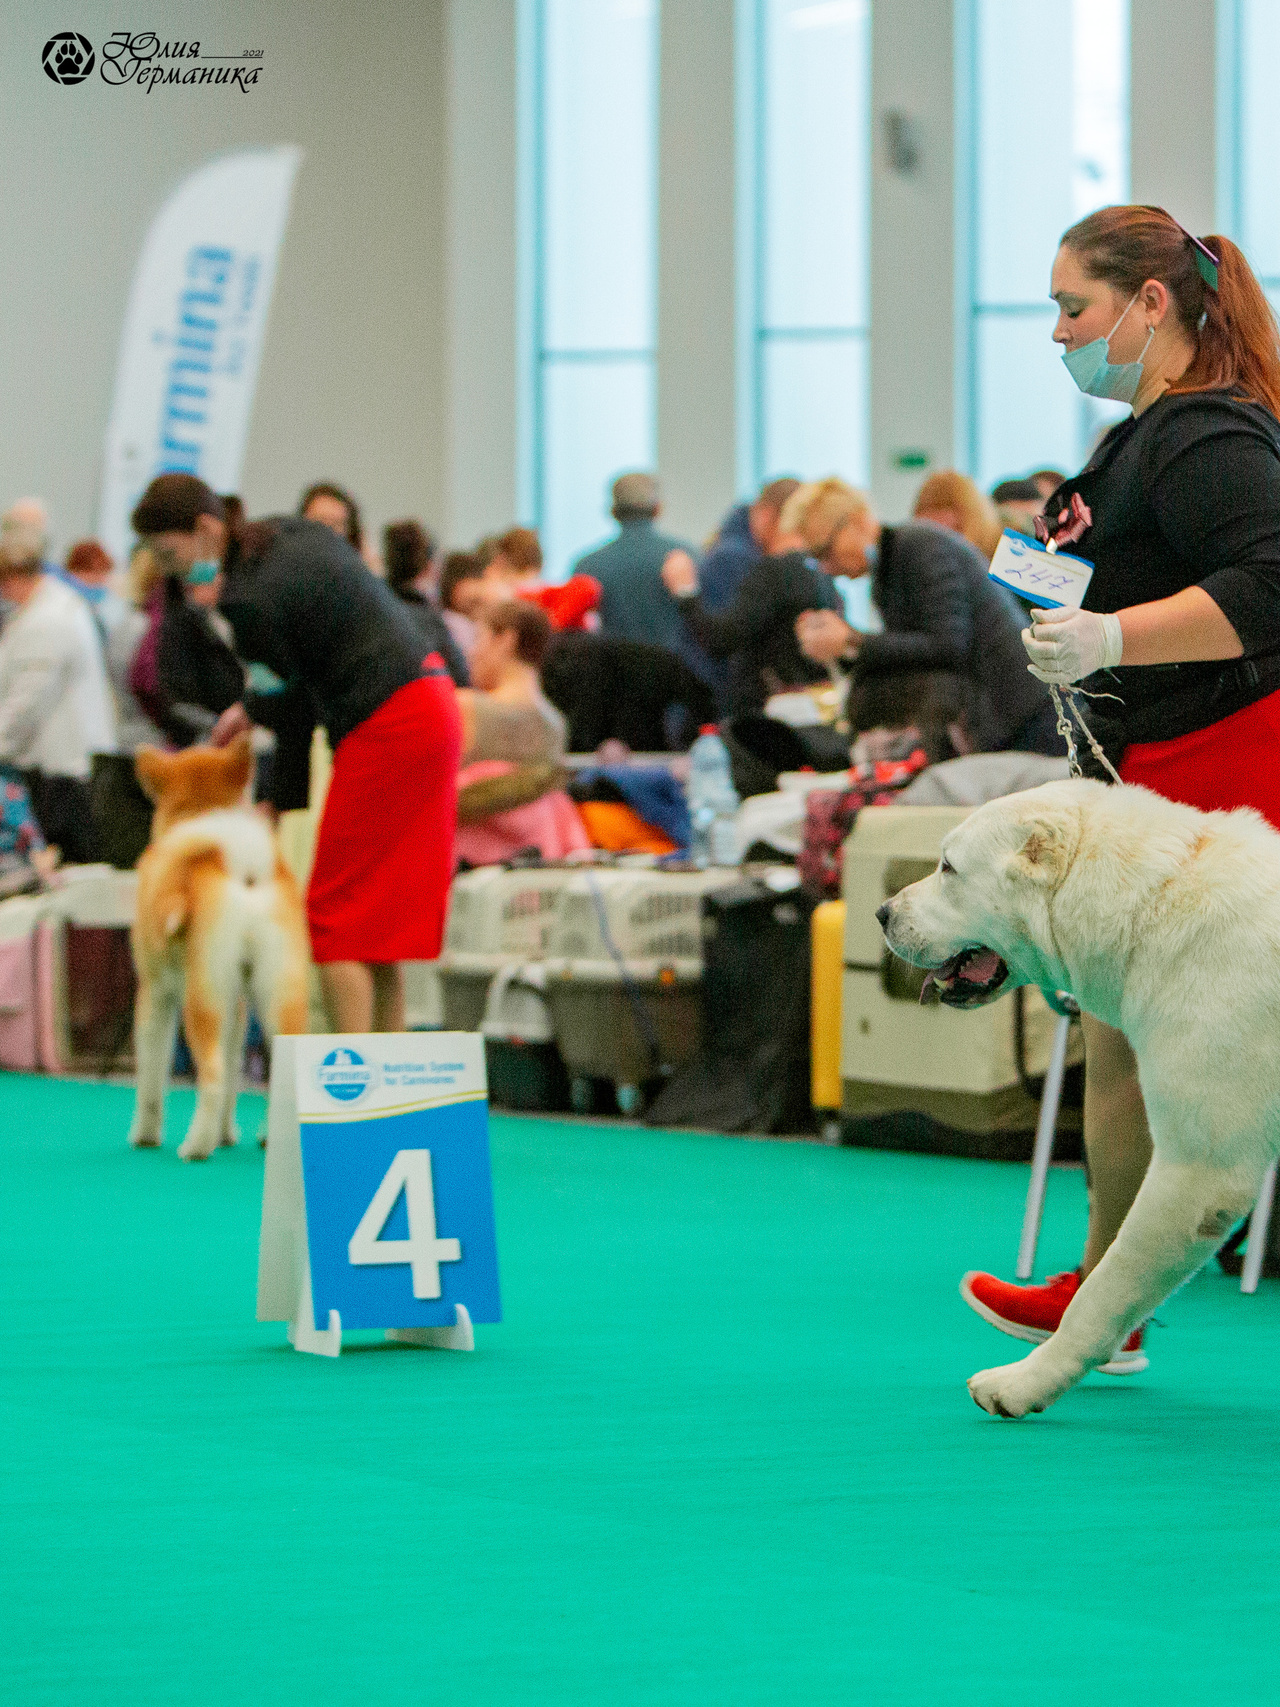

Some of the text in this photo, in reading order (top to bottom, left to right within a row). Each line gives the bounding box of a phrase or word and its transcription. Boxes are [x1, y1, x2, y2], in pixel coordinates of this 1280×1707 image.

[152, 245, 232, 477] rmina
[1004, 562, 1075, 590] 247
[348, 1148, 462, 1299] 4
